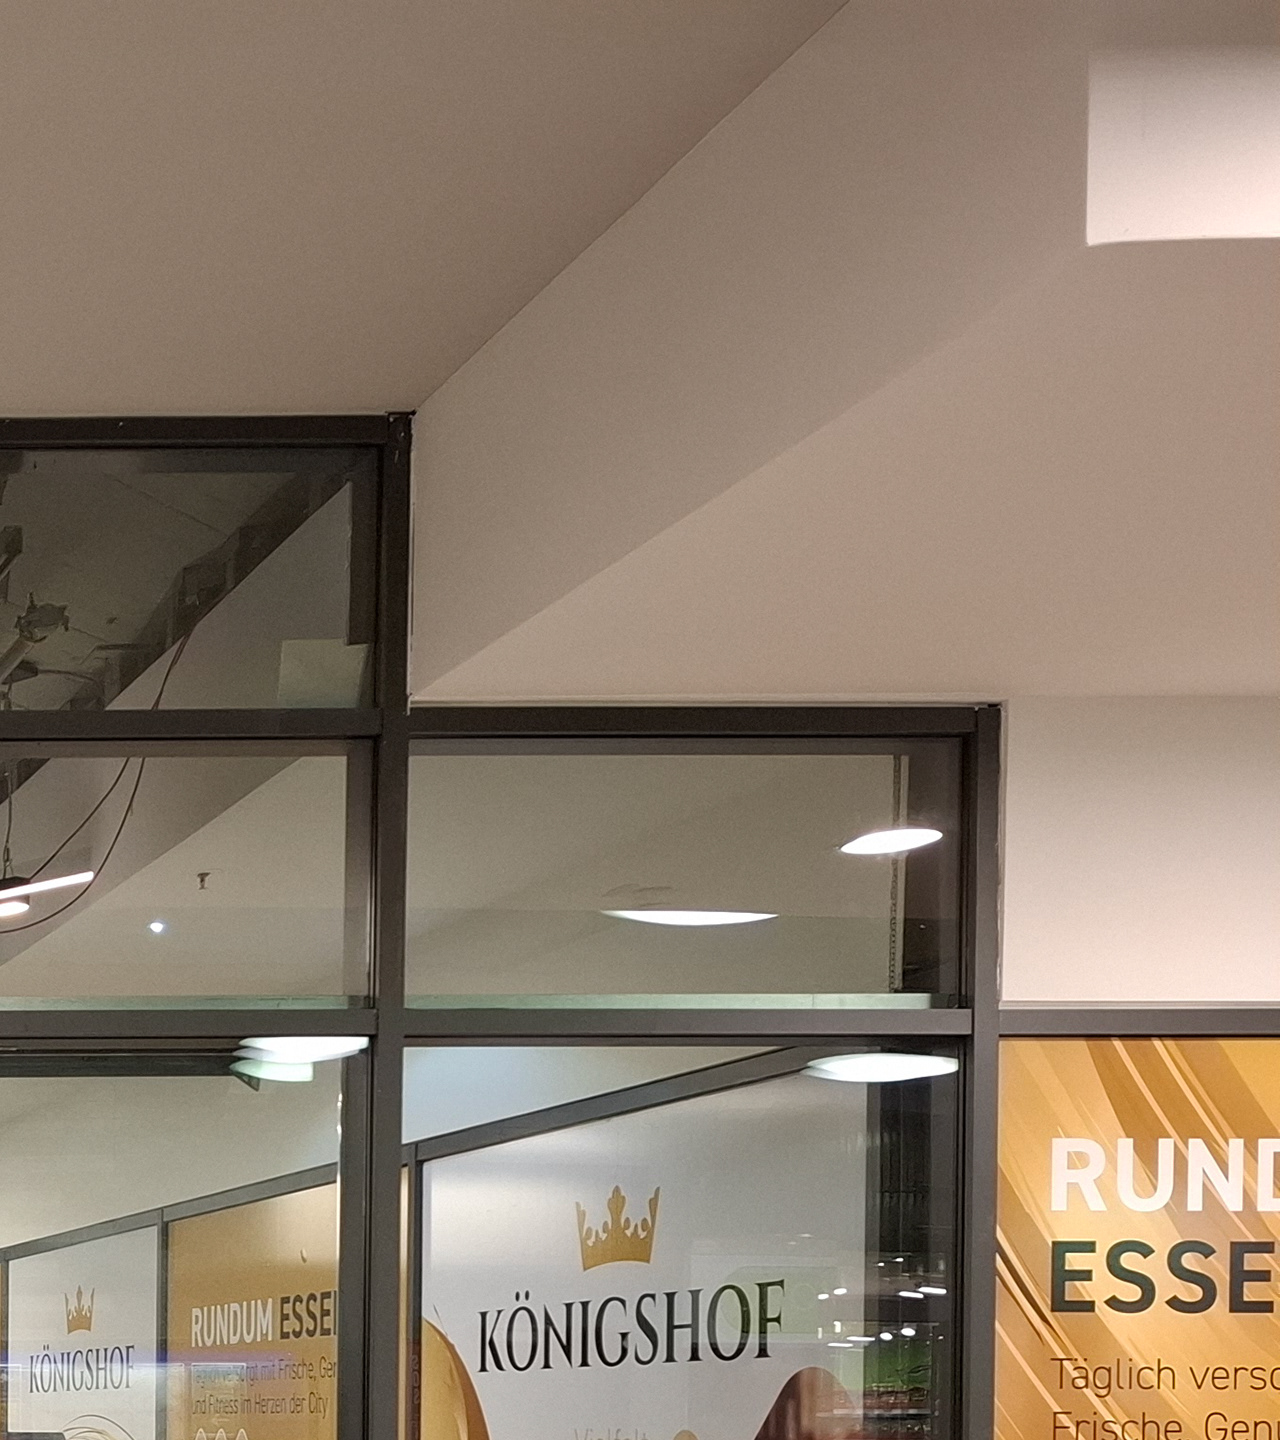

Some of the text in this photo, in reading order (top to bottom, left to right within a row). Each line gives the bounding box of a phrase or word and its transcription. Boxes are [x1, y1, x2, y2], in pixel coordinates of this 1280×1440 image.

[1051, 1239, 1276, 1314] ESSE
[191, 1290, 337, 1348] RUNDUM ESSE
[476, 1279, 786, 1373] KÖNIGSHOF
[29, 1344, 135, 1394] KÖNIGSHOF
[1050, 1358, 1176, 1399] Täglich
[253, 1393, 289, 1415] Herzen
[290, 1392, 306, 1415] der
[308, 1391, 329, 1420] City
